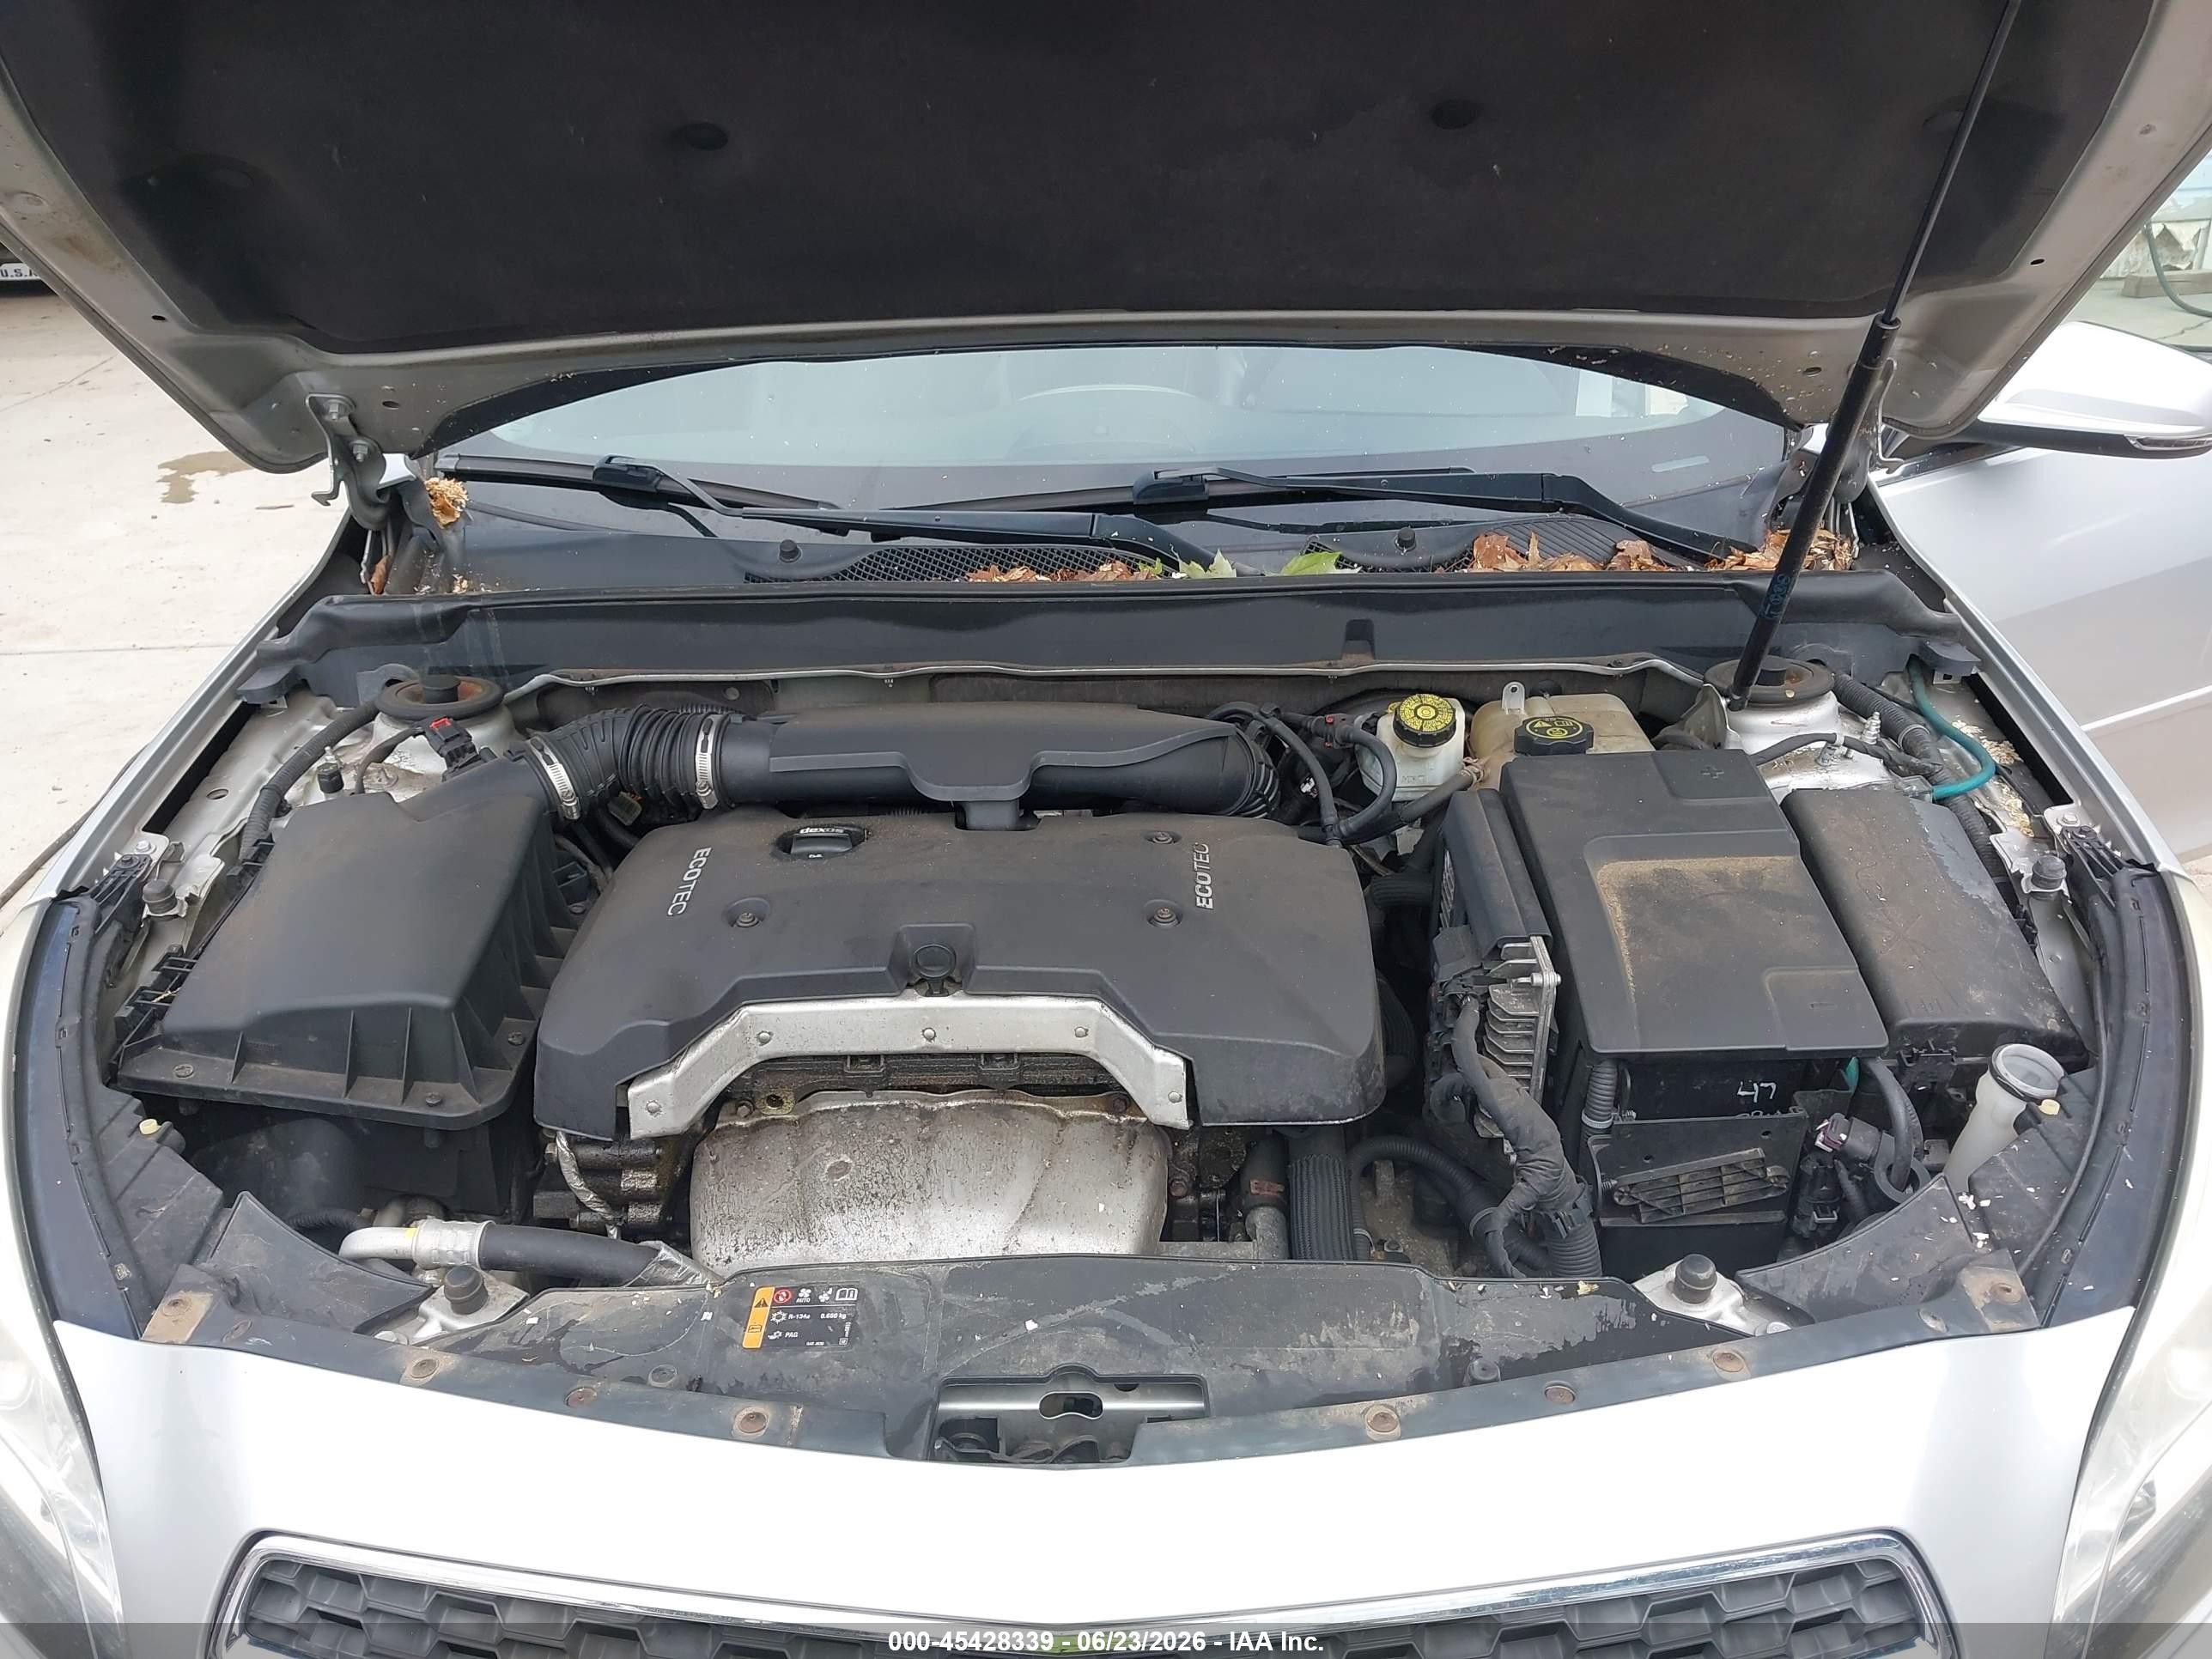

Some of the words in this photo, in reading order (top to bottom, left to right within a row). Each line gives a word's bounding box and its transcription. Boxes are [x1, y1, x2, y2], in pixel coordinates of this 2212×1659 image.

[667, 847, 713, 916] ECOTEC
[1194, 842, 1213, 908] ECOTEC
[1737, 1081, 1777, 1103] 47
